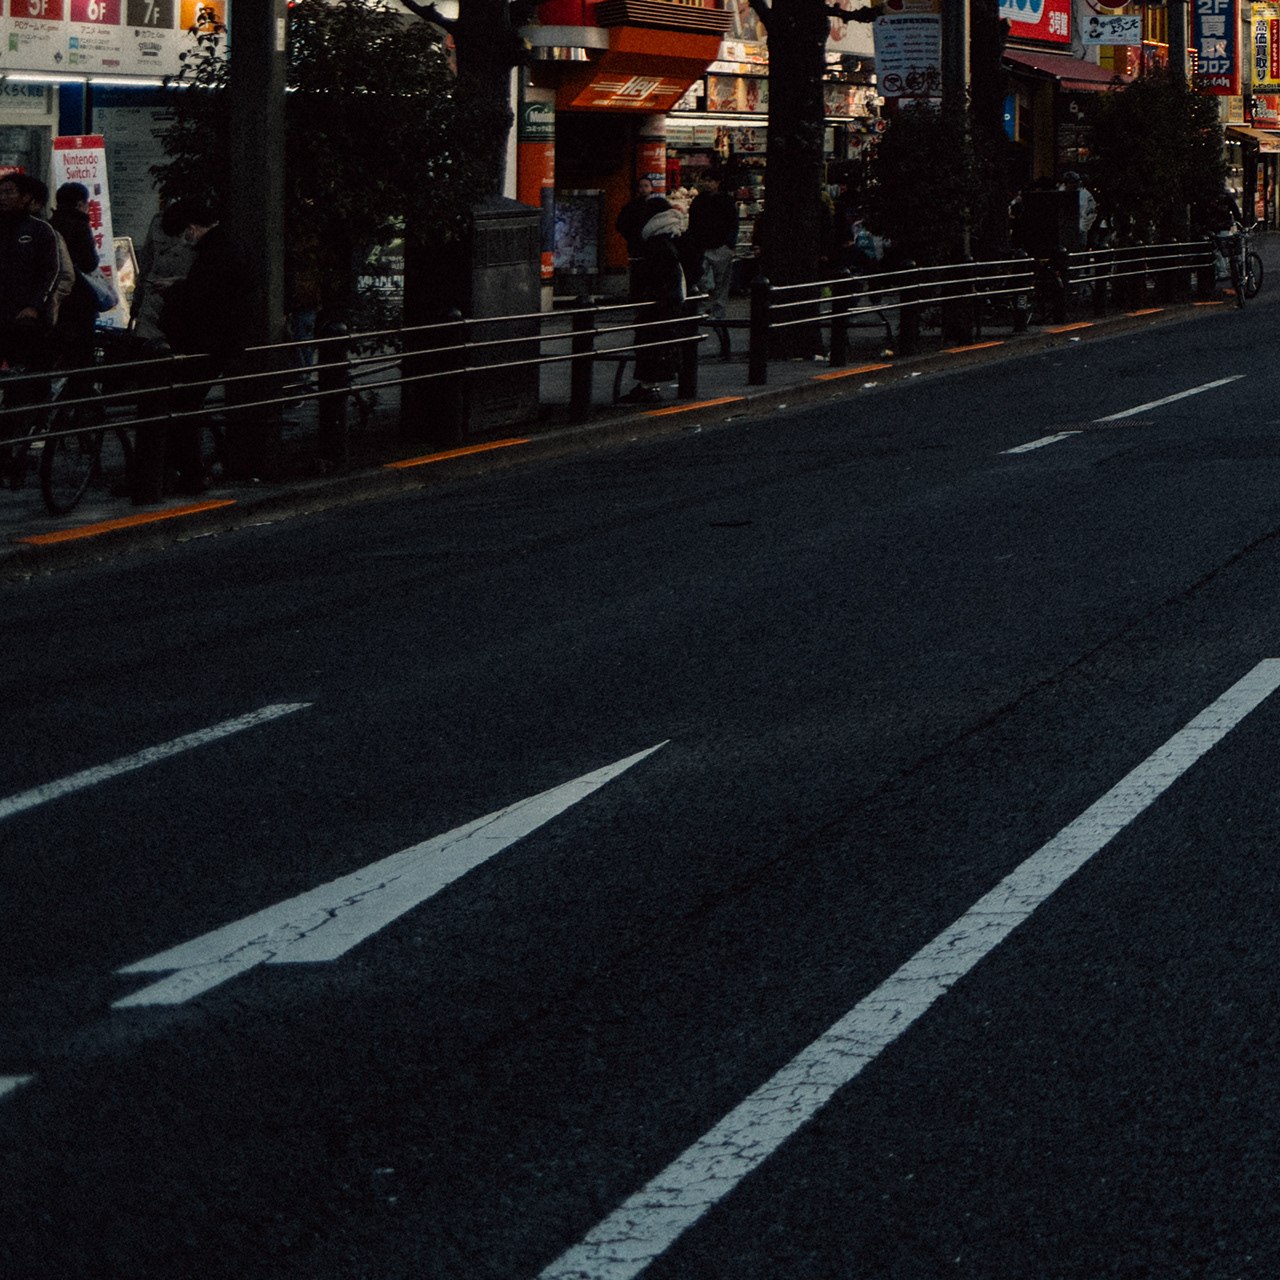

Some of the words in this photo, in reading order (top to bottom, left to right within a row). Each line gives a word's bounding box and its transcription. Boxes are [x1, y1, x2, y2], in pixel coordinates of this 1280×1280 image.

[1048, 10, 1068, 37] 3号館
[1201, 15, 1228, 59] 買取
[1254, 19, 1268, 82] 高価買取り
[0, 84, 44, 99] くらく買取
[619, 76, 658, 100] Hey
[63, 153, 98, 166] Nintendo
[66, 164, 91, 180] Switch
[92, 165, 97, 179] 2
